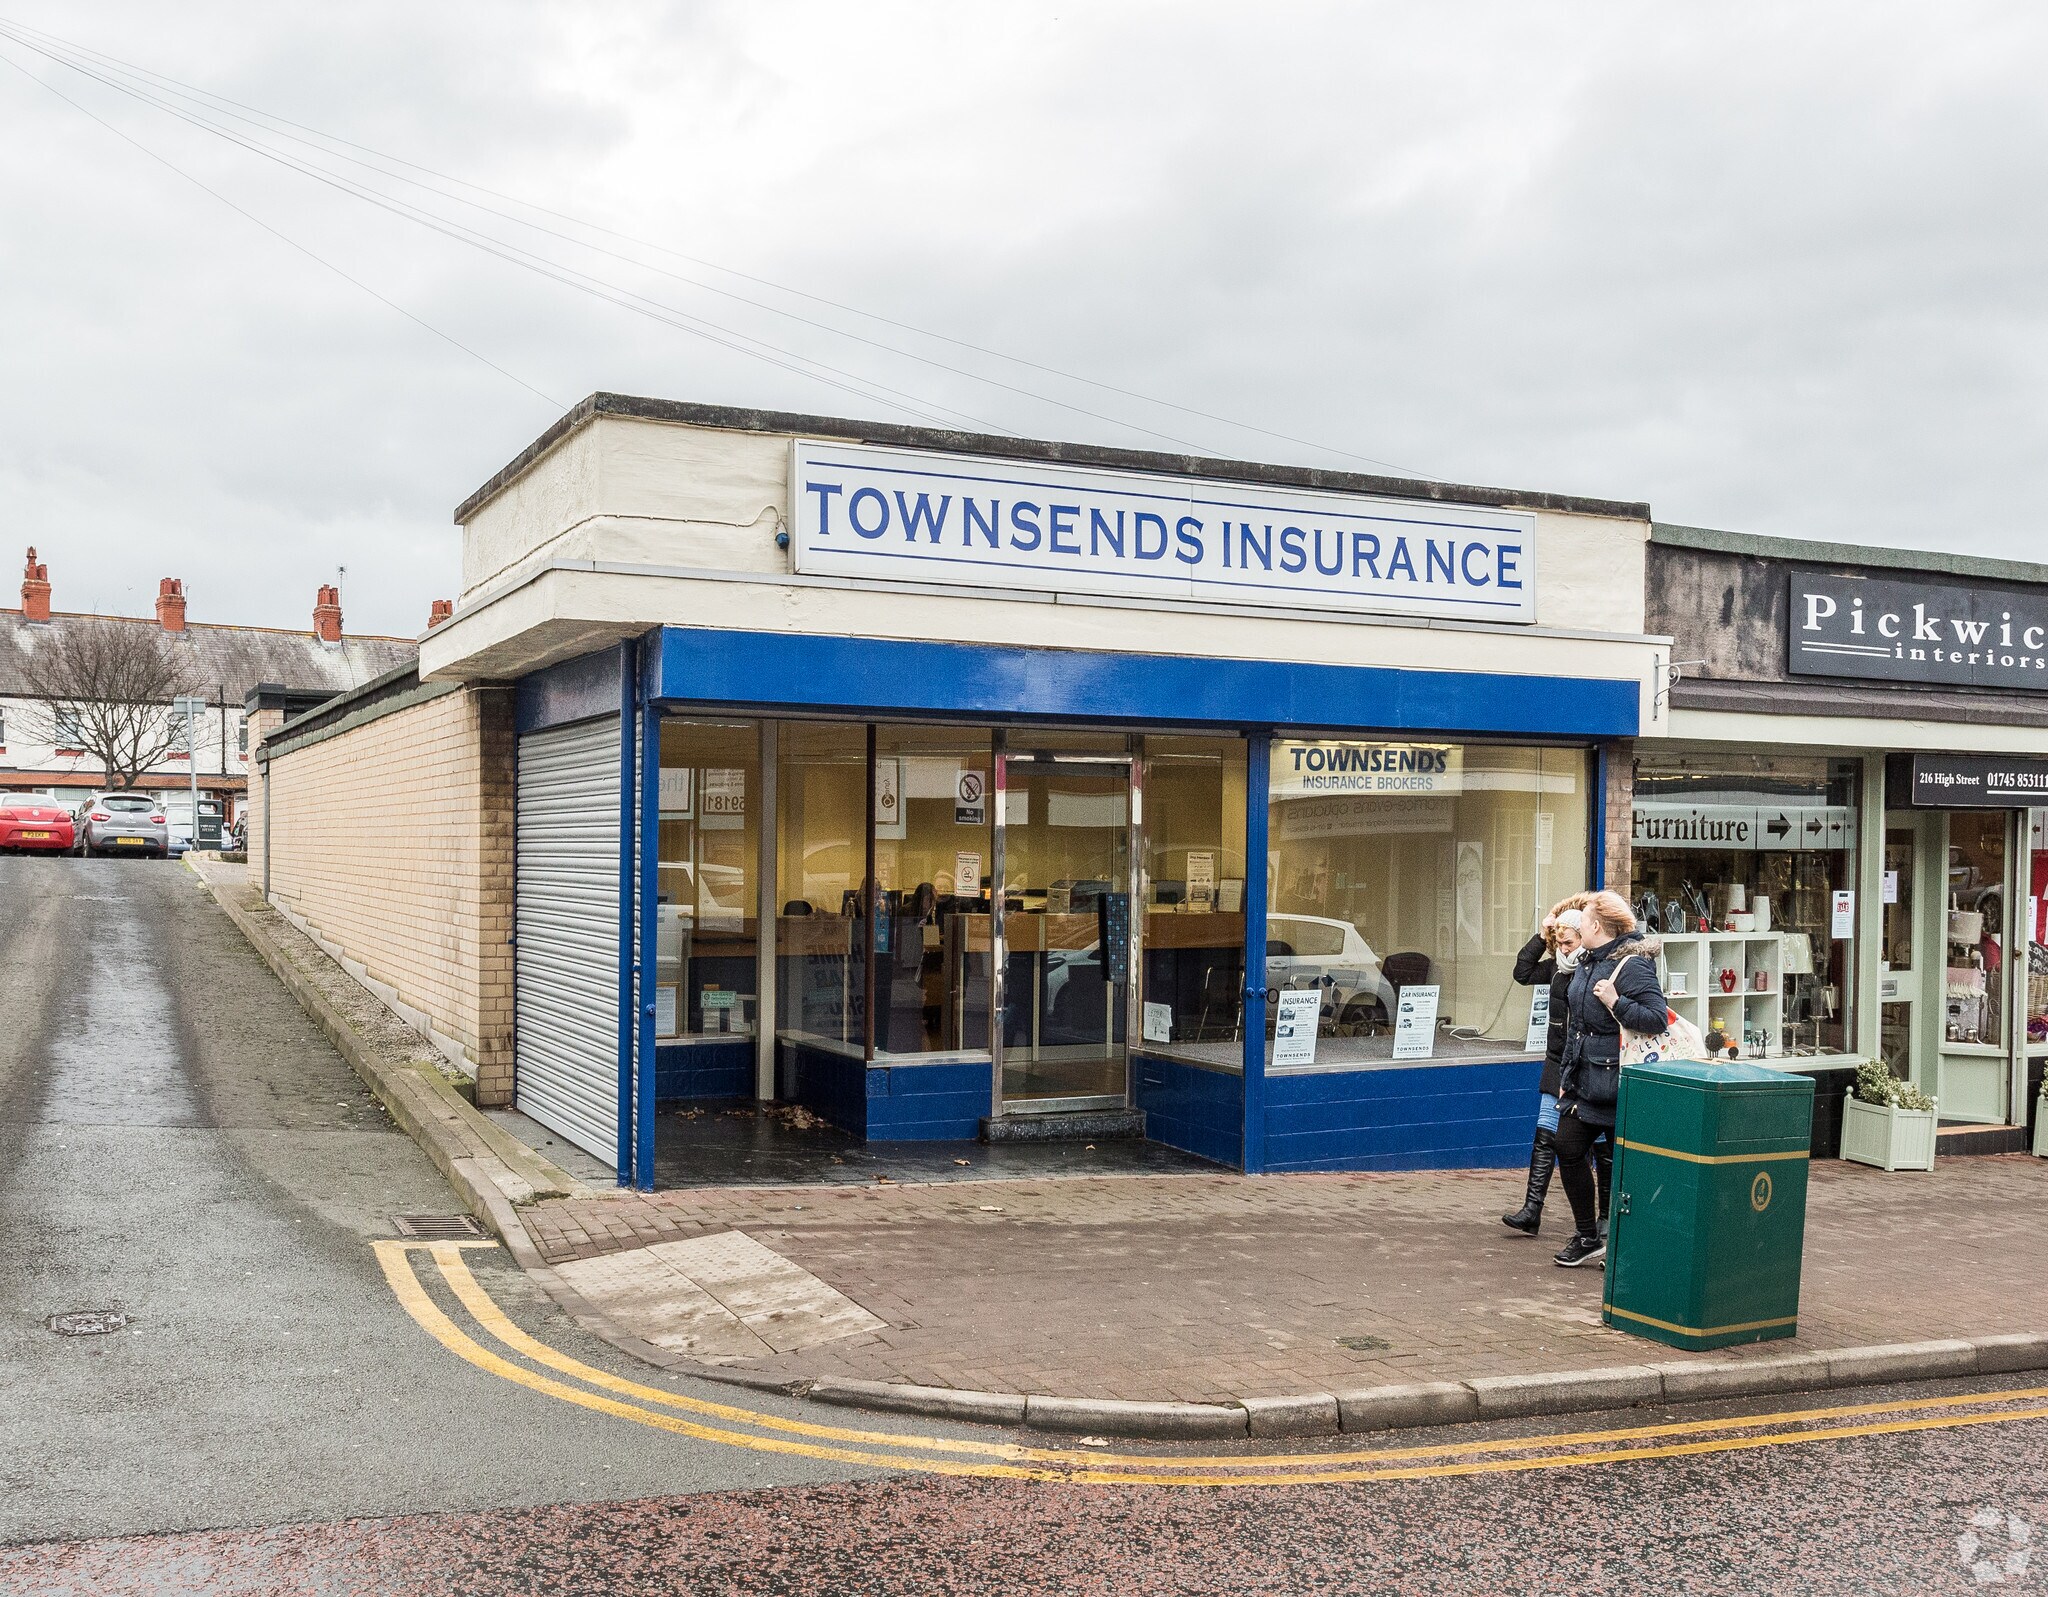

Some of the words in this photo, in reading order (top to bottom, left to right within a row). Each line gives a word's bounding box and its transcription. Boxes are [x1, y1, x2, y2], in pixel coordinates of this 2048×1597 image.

[805, 481, 1204, 565] TOWNSENDS
[1221, 521, 1523, 589] INSURANCE
[1802, 593, 2045, 650] Pickwic
[1895, 642, 2046, 669] interiors
[1290, 748, 1447, 774] TOWNSENDS
[1303, 775, 1372, 790] INSURANCE
[1377, 776, 1433, 791] BROKERS
[1920, 773, 1933, 784] 216
[1935, 773, 1955, 787] High
[1956, 773, 1980, 785] Street
[1987, 772, 2015, 787] 01745
[959, 815, 980, 823] smoking
[1632, 809, 1749, 841] Furniture
[1282, 996, 1318, 1005] INSURANCE
